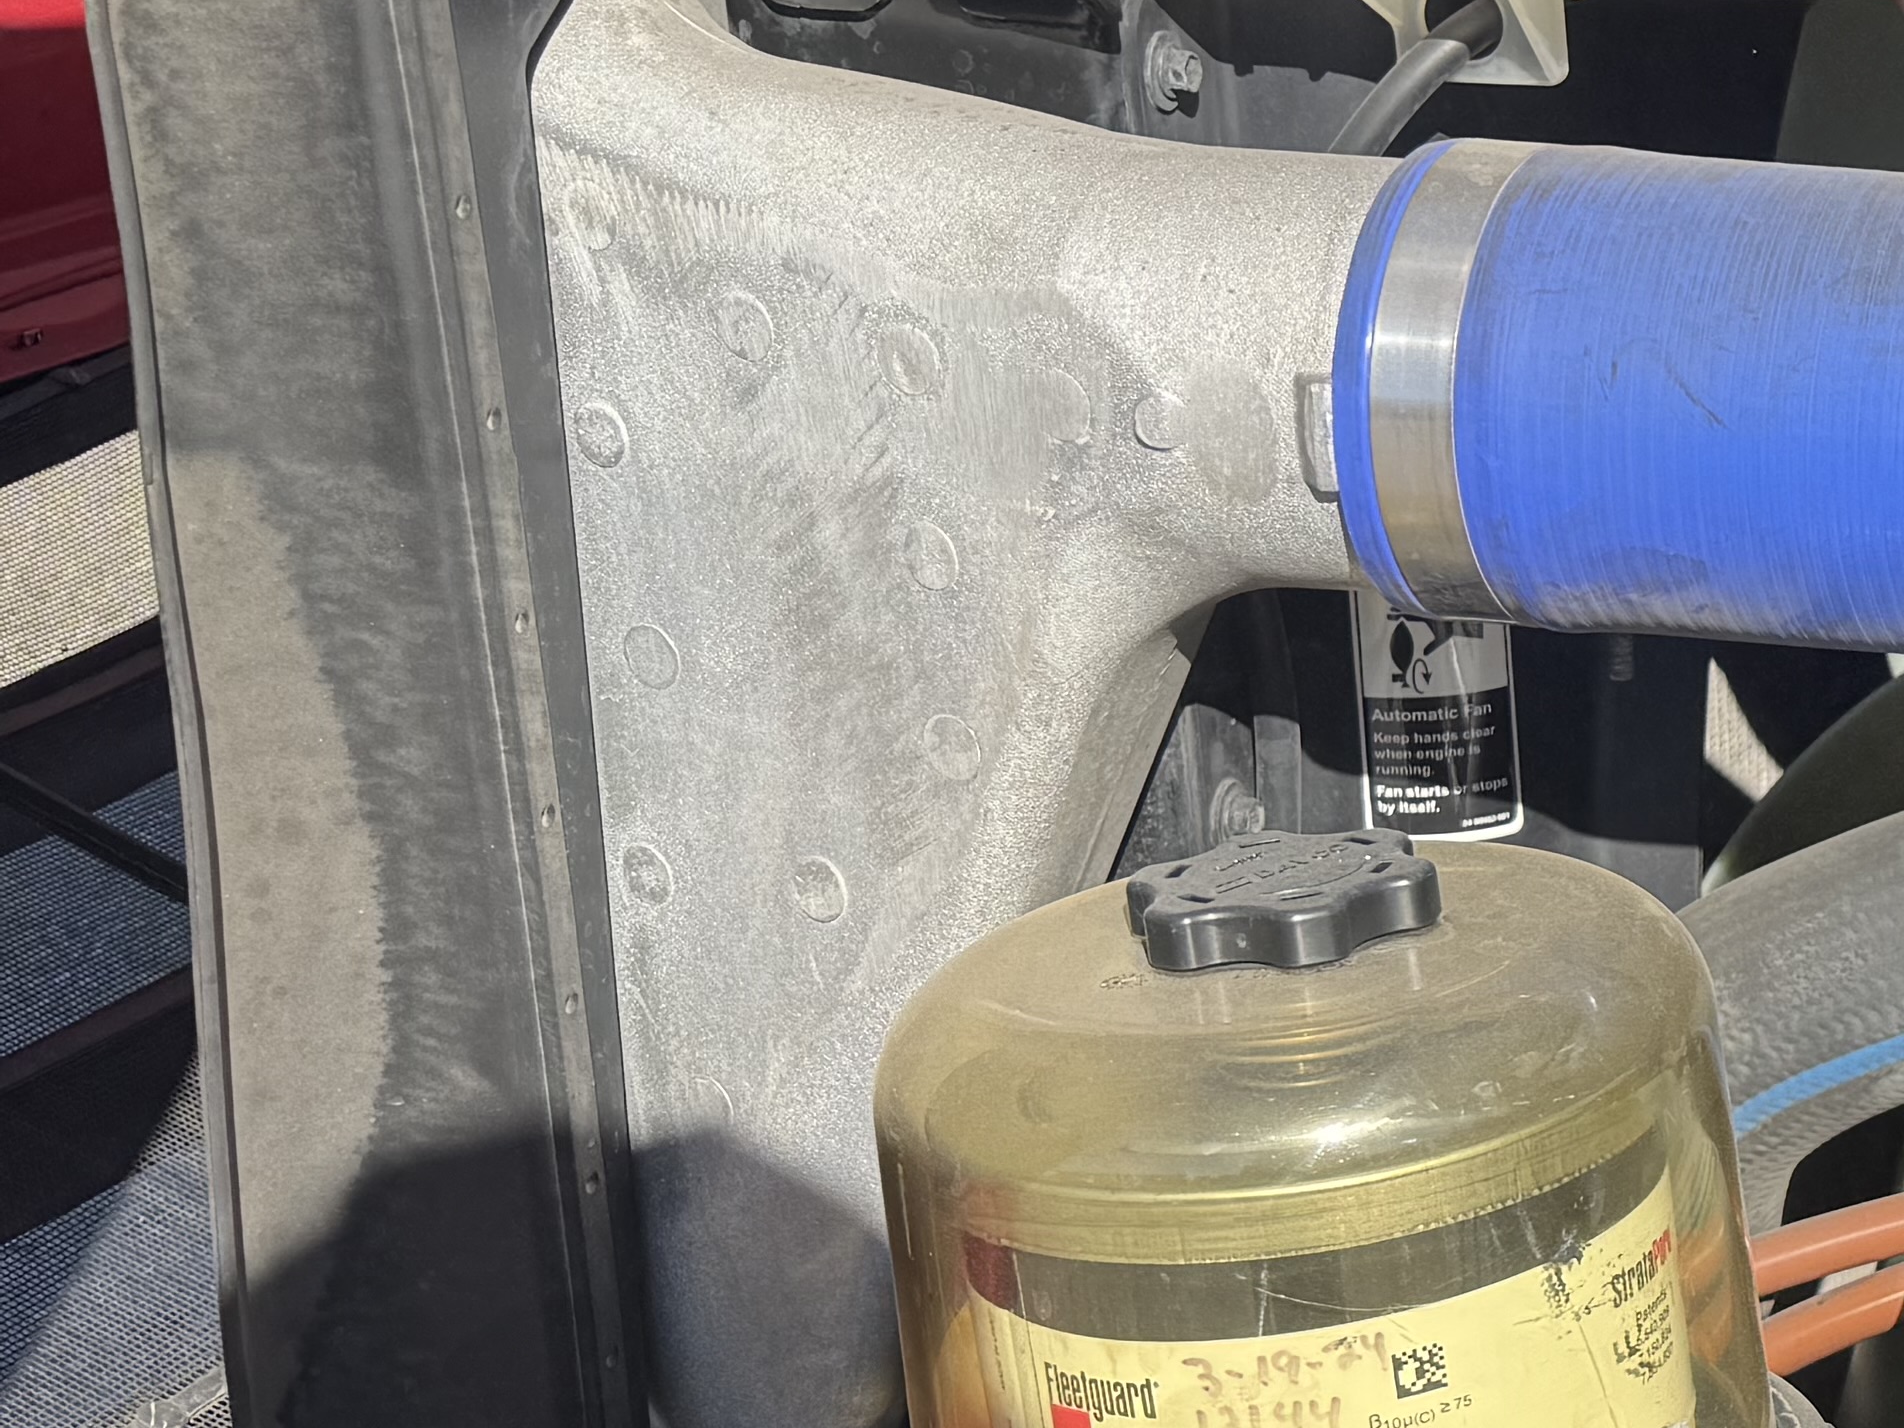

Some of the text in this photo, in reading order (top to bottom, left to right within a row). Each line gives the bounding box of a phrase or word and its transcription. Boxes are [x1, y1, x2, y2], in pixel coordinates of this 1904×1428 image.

[1372, 703, 1492, 722] Automatic Fan
[1374, 725, 1495, 745] Keep hands clear
[1374, 745, 1480, 761] when engine is
[1375, 765, 1435, 776] running.
[1377, 776, 1508, 797] Fan starts or stops
[1377, 800, 1441, 816] by itself.
[1044, 1361, 1157, 1422] Fleetguard
